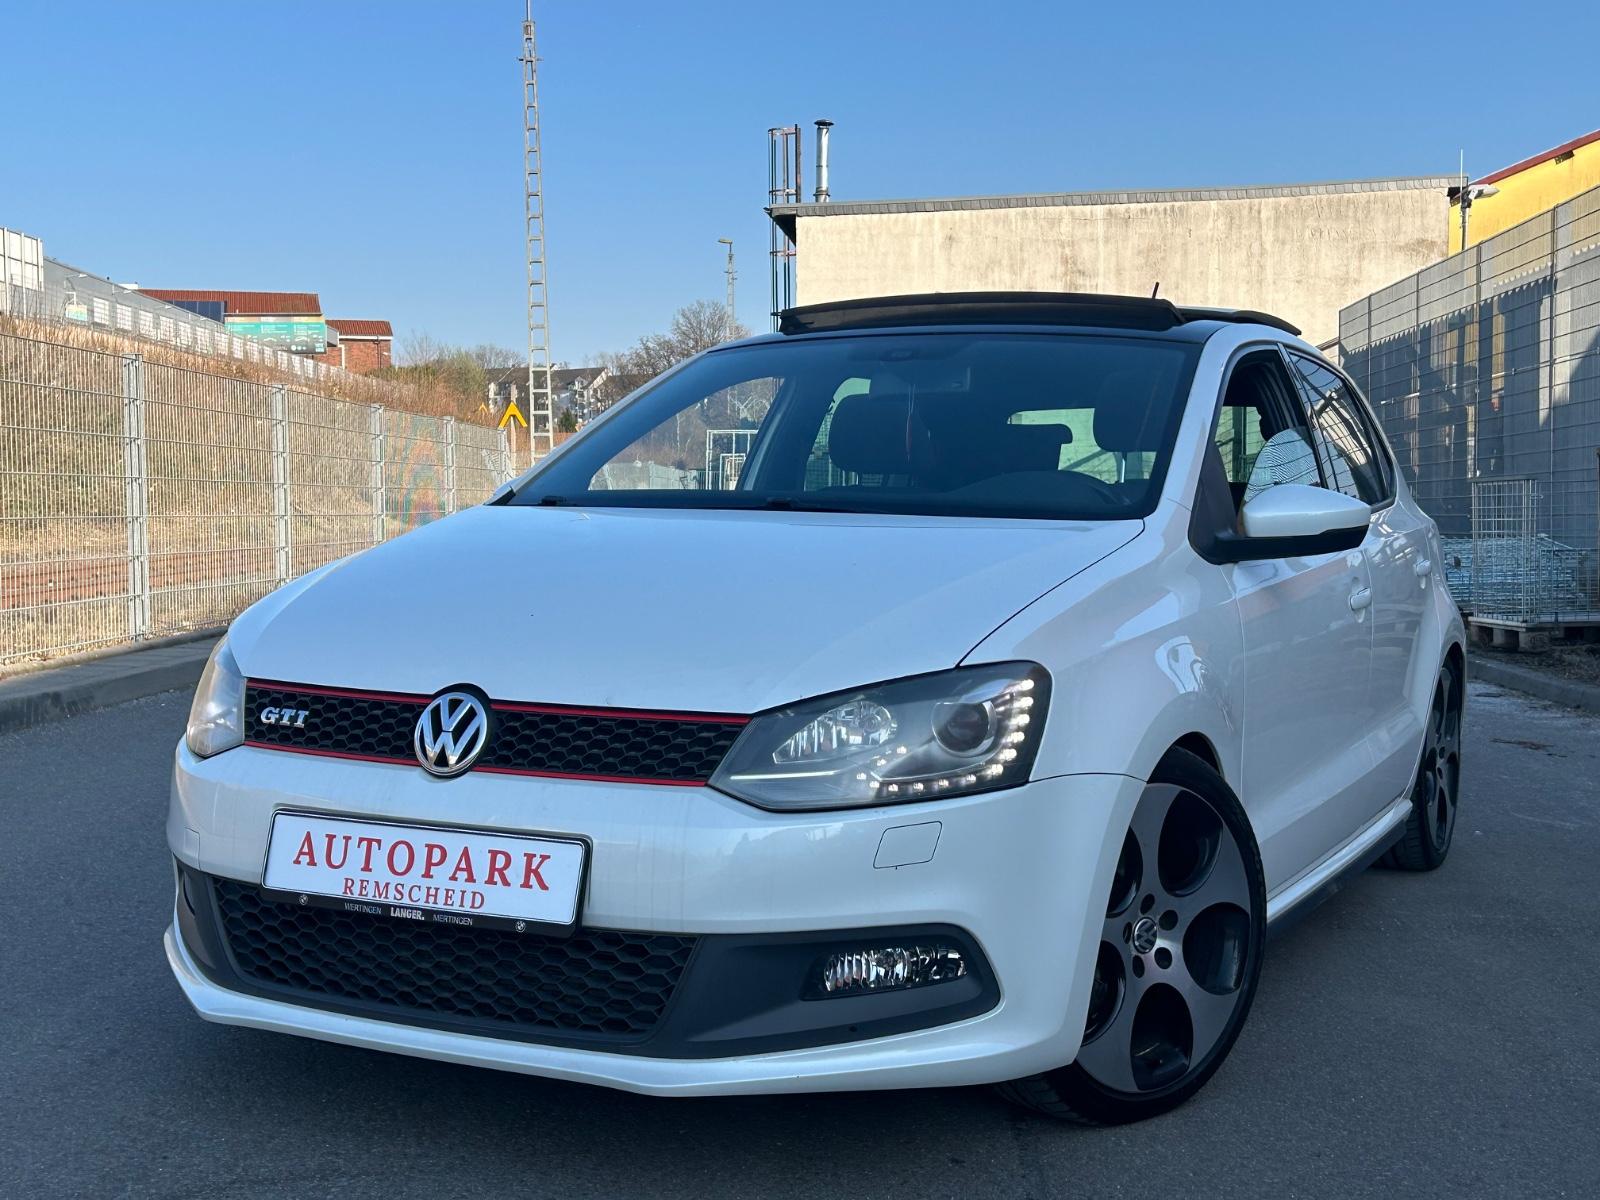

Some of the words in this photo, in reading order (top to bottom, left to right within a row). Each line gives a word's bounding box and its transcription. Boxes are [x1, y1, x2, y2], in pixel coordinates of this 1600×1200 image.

[260, 706, 309, 728] GTI
[293, 830, 551, 890] AUTOPARK
[342, 877, 485, 909] REMSCHEID
